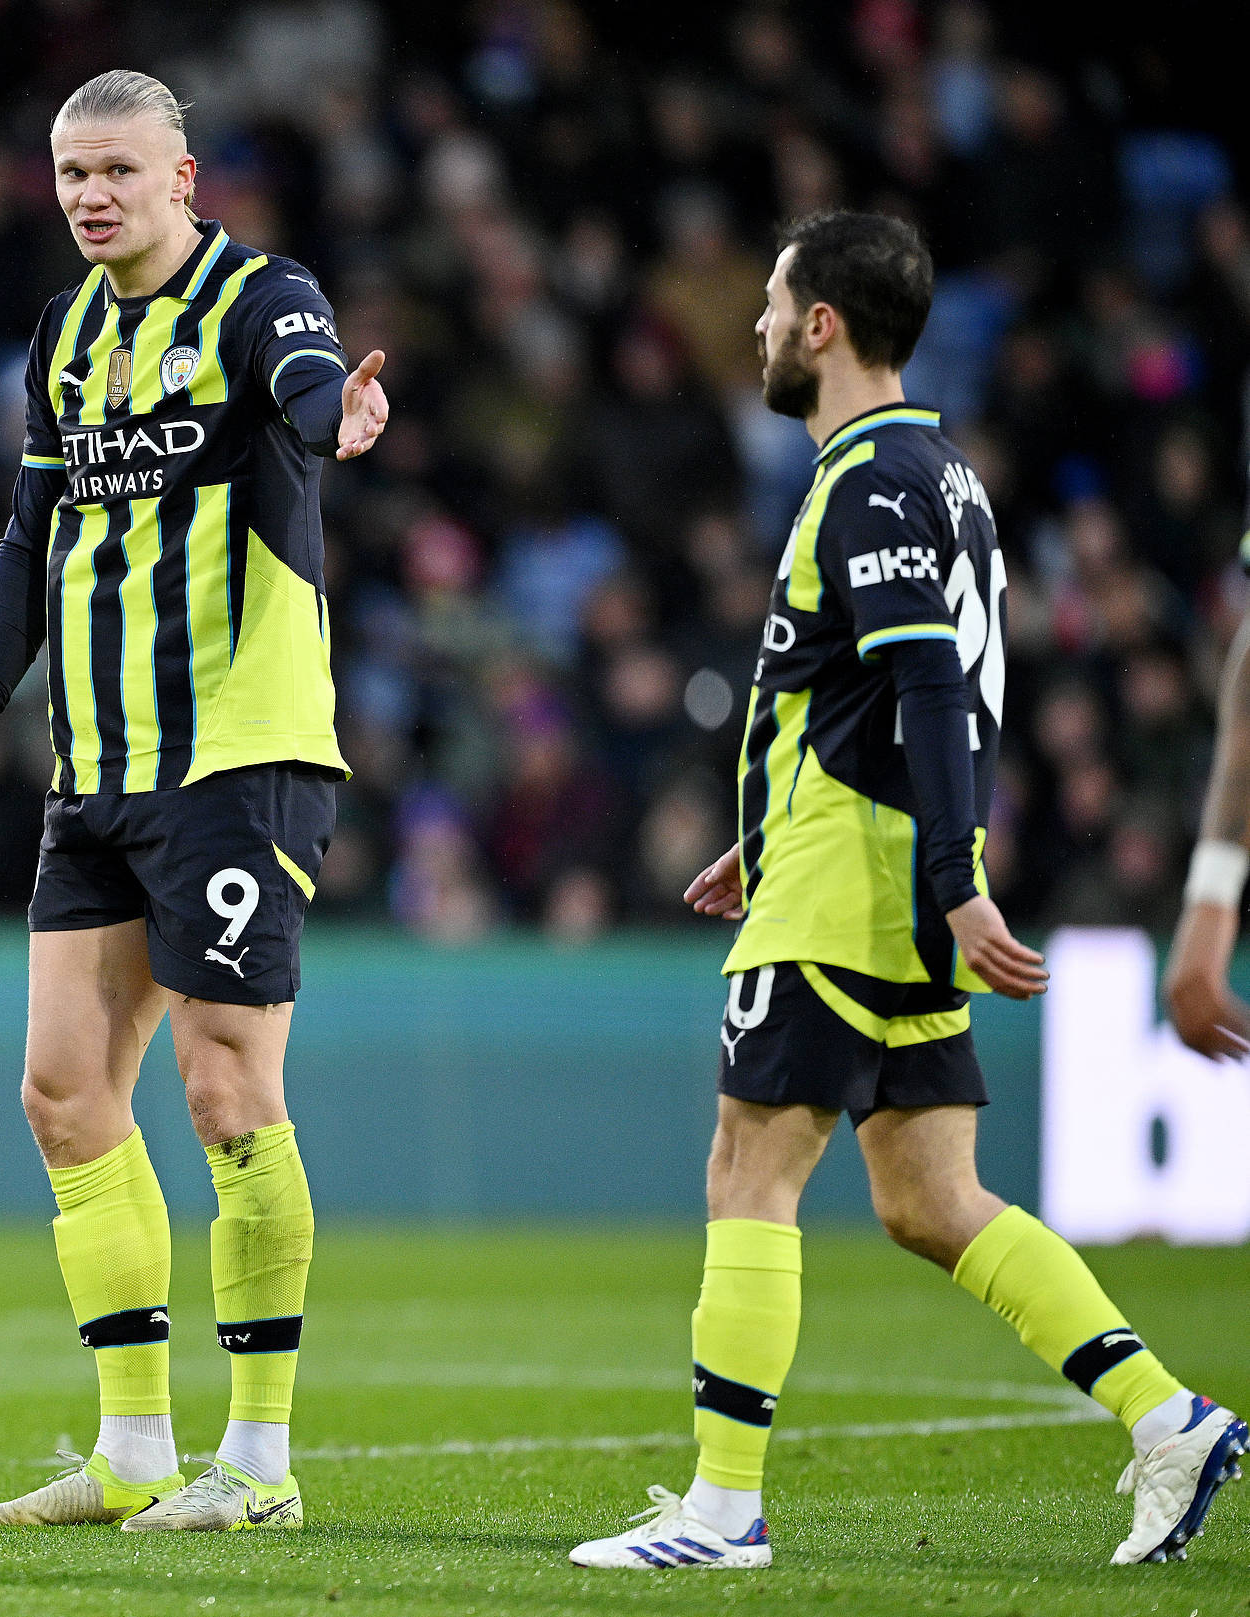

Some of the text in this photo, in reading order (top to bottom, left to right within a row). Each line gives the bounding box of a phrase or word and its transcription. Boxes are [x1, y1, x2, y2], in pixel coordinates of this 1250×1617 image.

[61, 420, 206, 468] ETIHAD
[73, 468, 164, 498] AIRWAYS
[848, 547, 939, 589] OKX
[206, 867, 260, 946] 9
